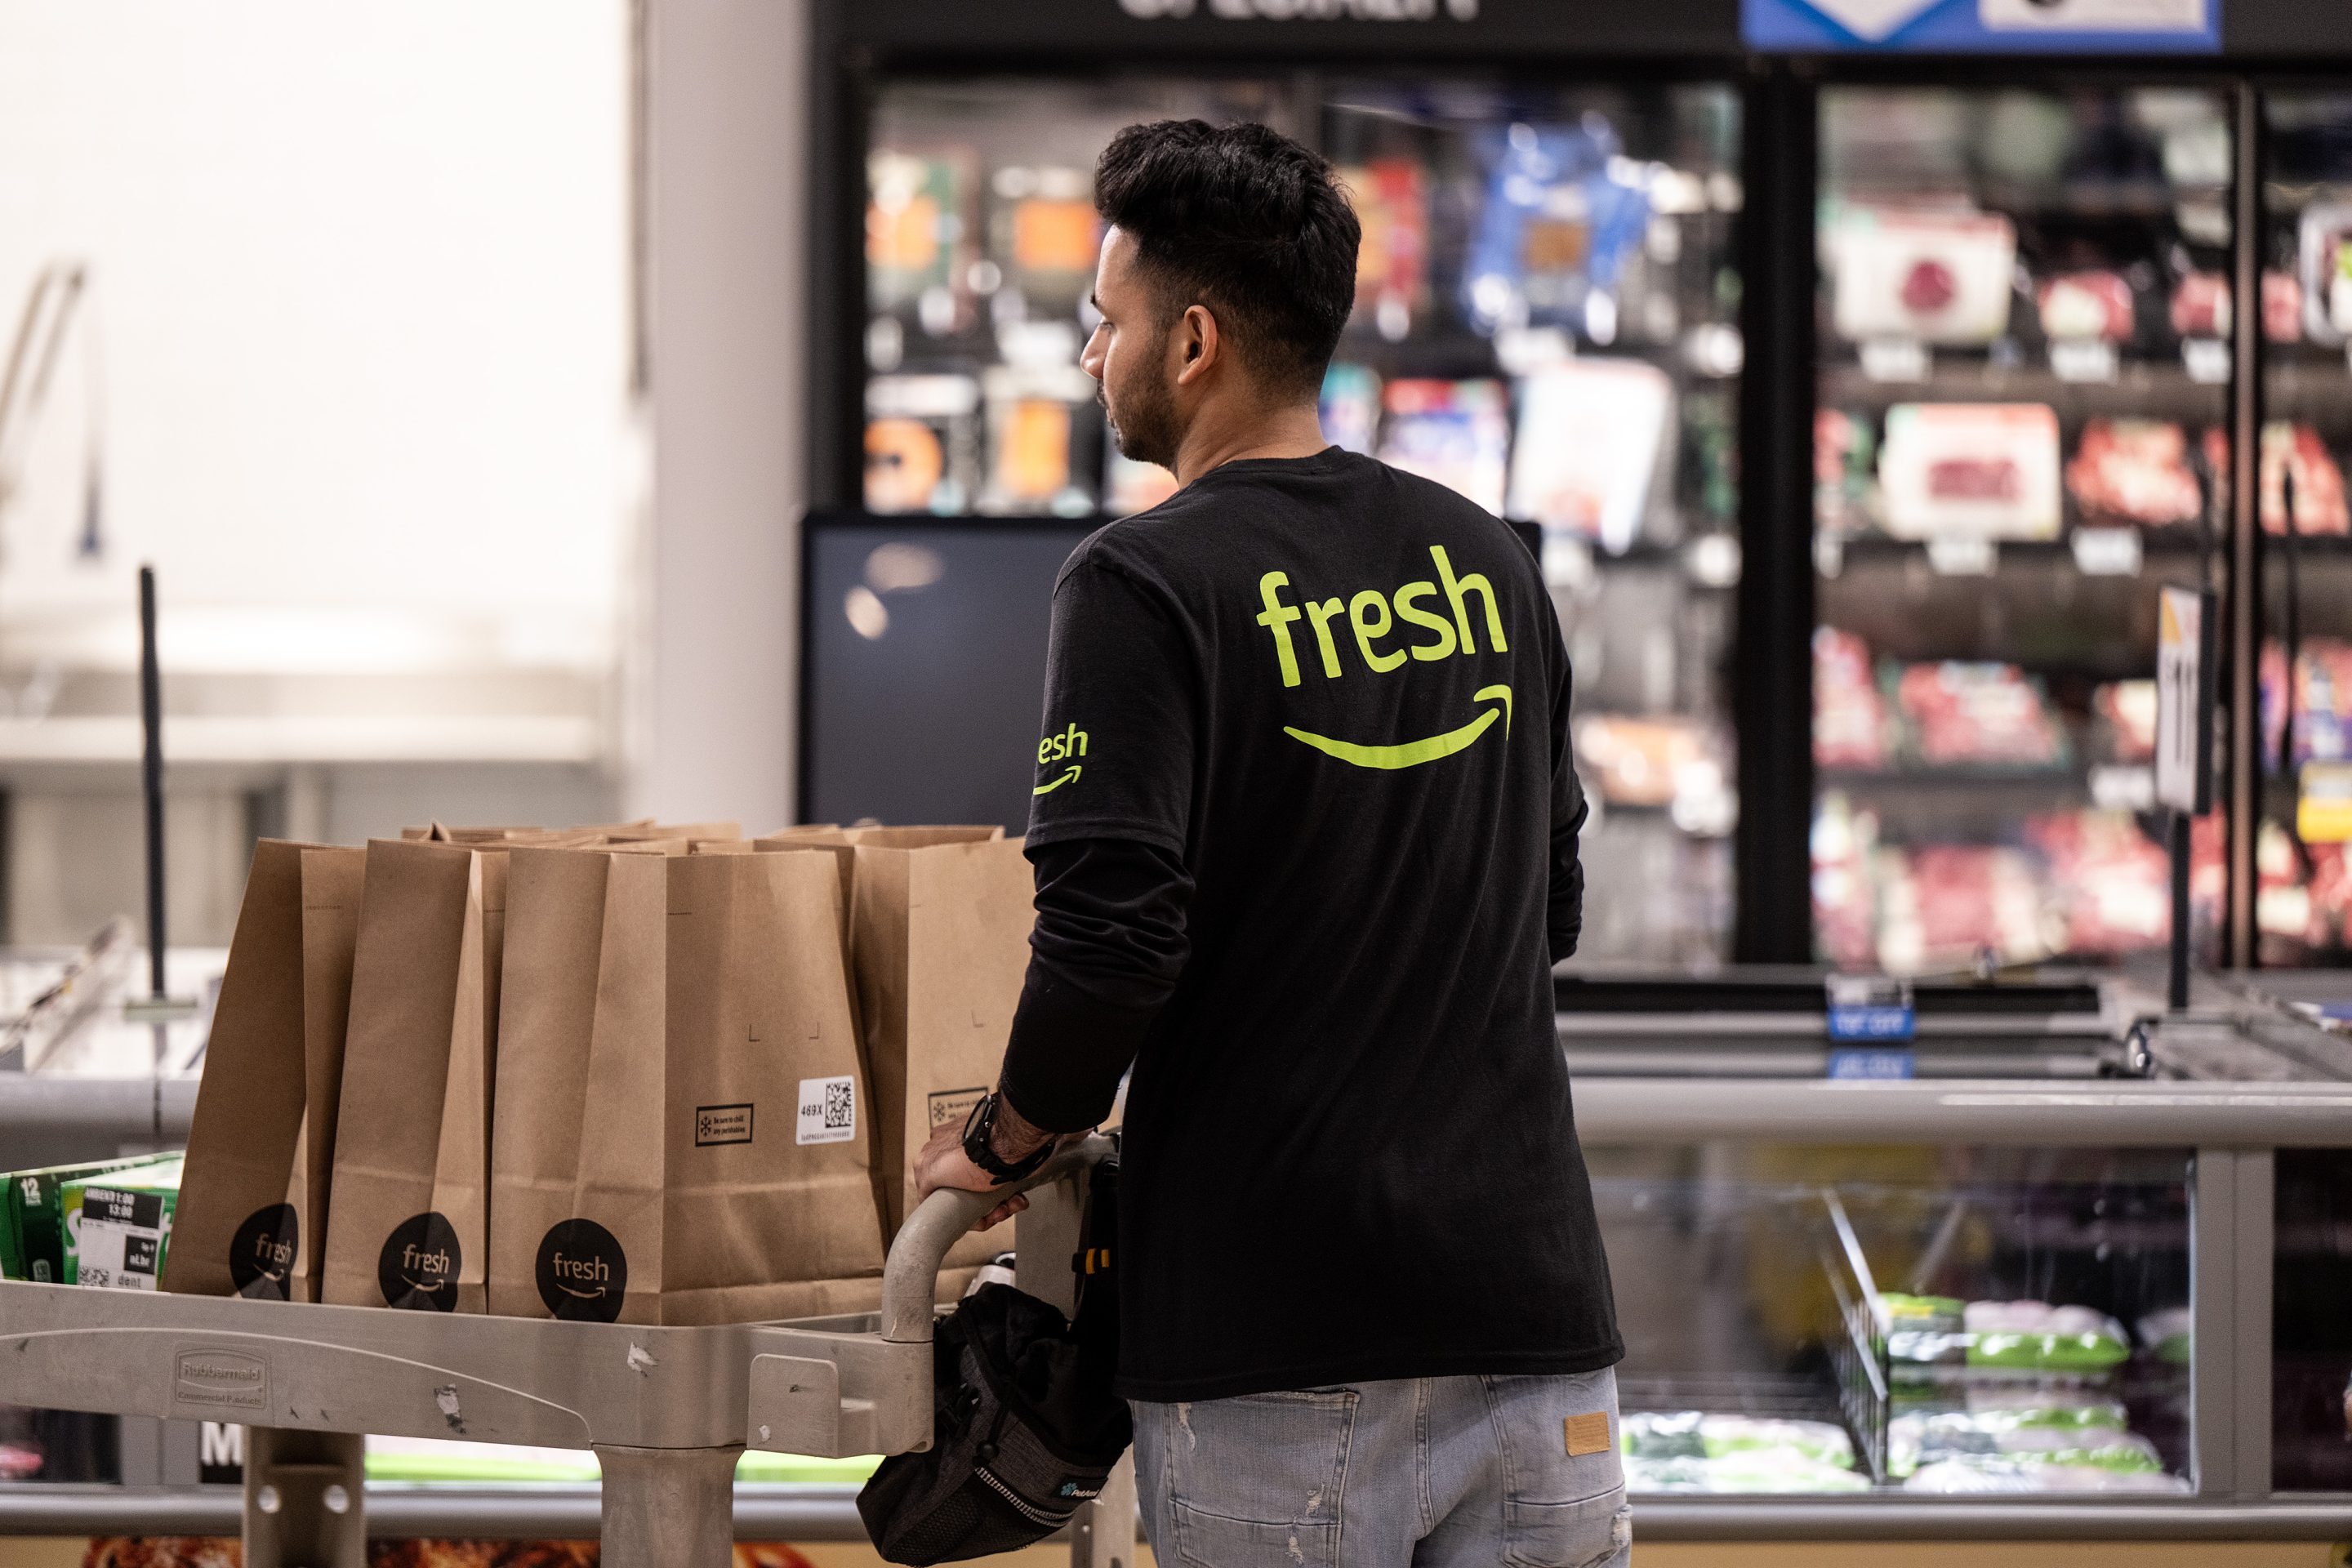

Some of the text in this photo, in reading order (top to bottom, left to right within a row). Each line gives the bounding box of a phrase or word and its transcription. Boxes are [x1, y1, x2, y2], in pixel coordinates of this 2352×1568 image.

[1257, 546, 1508, 687] fresh
[1038, 723, 1088, 764] esh
[20, 1177, 41, 1197] 12
[256, 1232, 292, 1265] fresh
[403, 1243, 450, 1275] fresh
[553, 1252, 610, 1282] fresh
